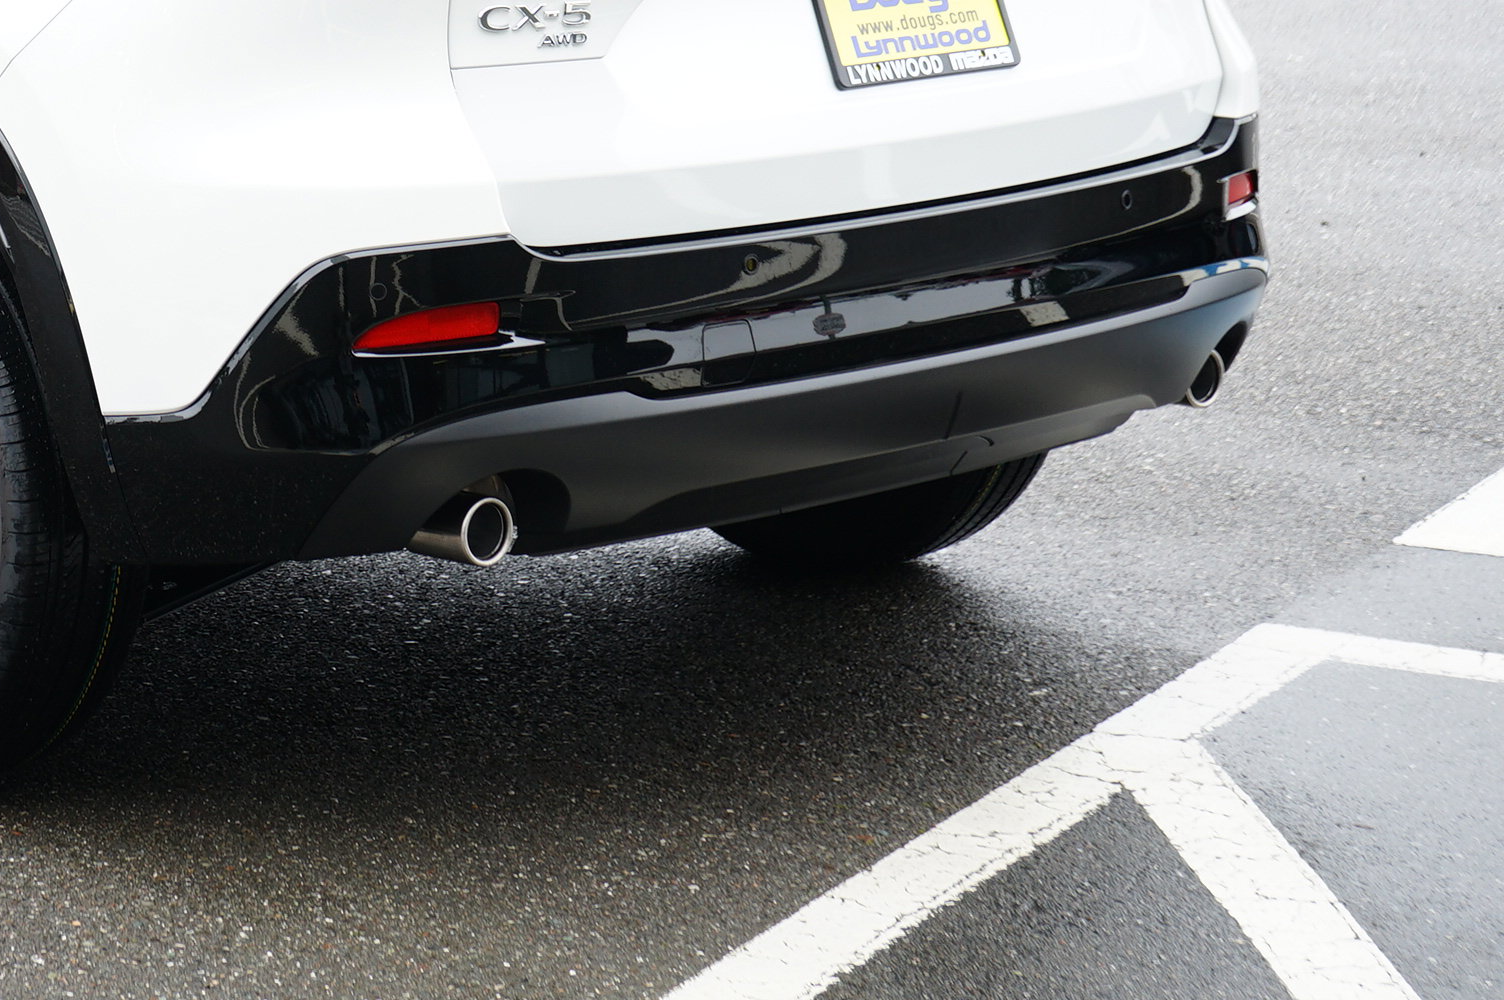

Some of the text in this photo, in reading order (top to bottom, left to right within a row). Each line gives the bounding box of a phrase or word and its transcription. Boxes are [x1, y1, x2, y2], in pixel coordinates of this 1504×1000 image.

[477, 0, 592, 33] CX-5
[857, 9, 979, 36] www.dougs.com
[537, 31, 588, 49] AWD
[850, 19, 991, 58] Lynnwood
[846, 54, 944, 85] LYNNWOOD
